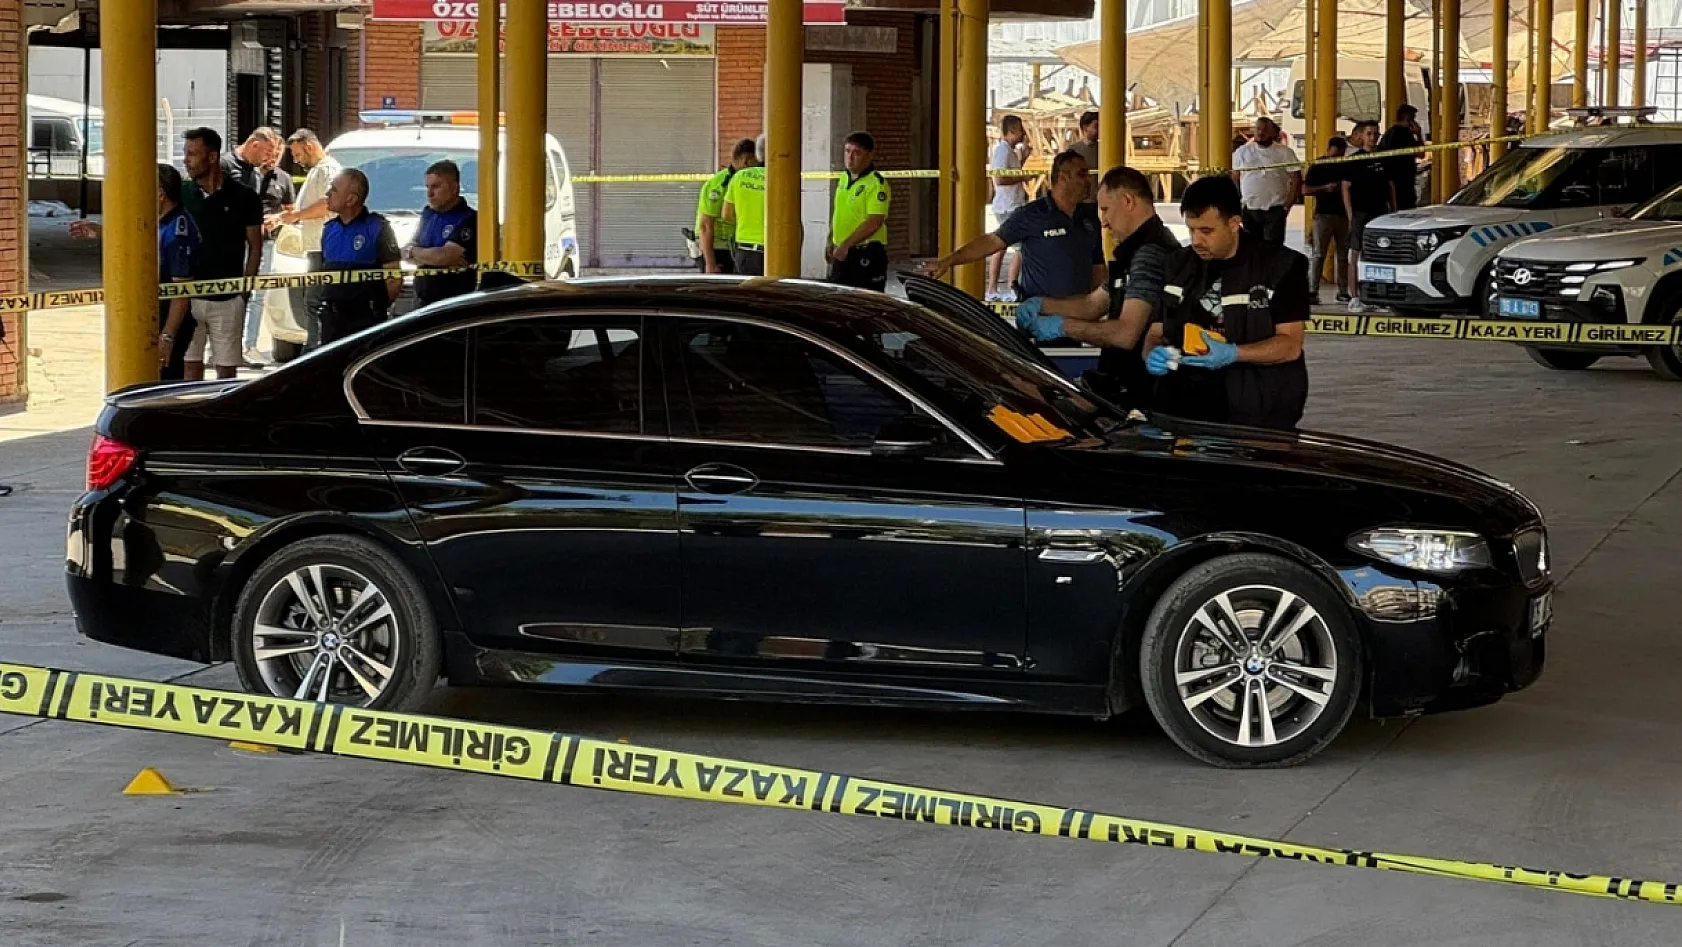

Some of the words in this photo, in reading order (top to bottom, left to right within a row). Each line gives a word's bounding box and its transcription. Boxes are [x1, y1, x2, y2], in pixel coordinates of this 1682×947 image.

[547, 2, 664, 19] EBELOĞLU
[720, 3, 768, 13] ÜRÜNLE
[50, 291, 104, 306] İLMEZ
[158, 285, 190, 296] YER
[1311, 318, 1349, 332] YERİ
[1375, 319, 1451, 335] GİRİLMEZ
[1471, 325, 1517, 338] KAZA
[1522, 324, 1561, 339] YERİ
[1587, 325, 1666, 342] GİRİLMEZ
[90, 681, 181, 721] YERİ
[192, 693, 303, 736] KAZA
[350, 714, 531, 770] GİRİLMEZ
[592, 747, 684, 789] YERİ
[695, 761, 807, 806] KAZA
